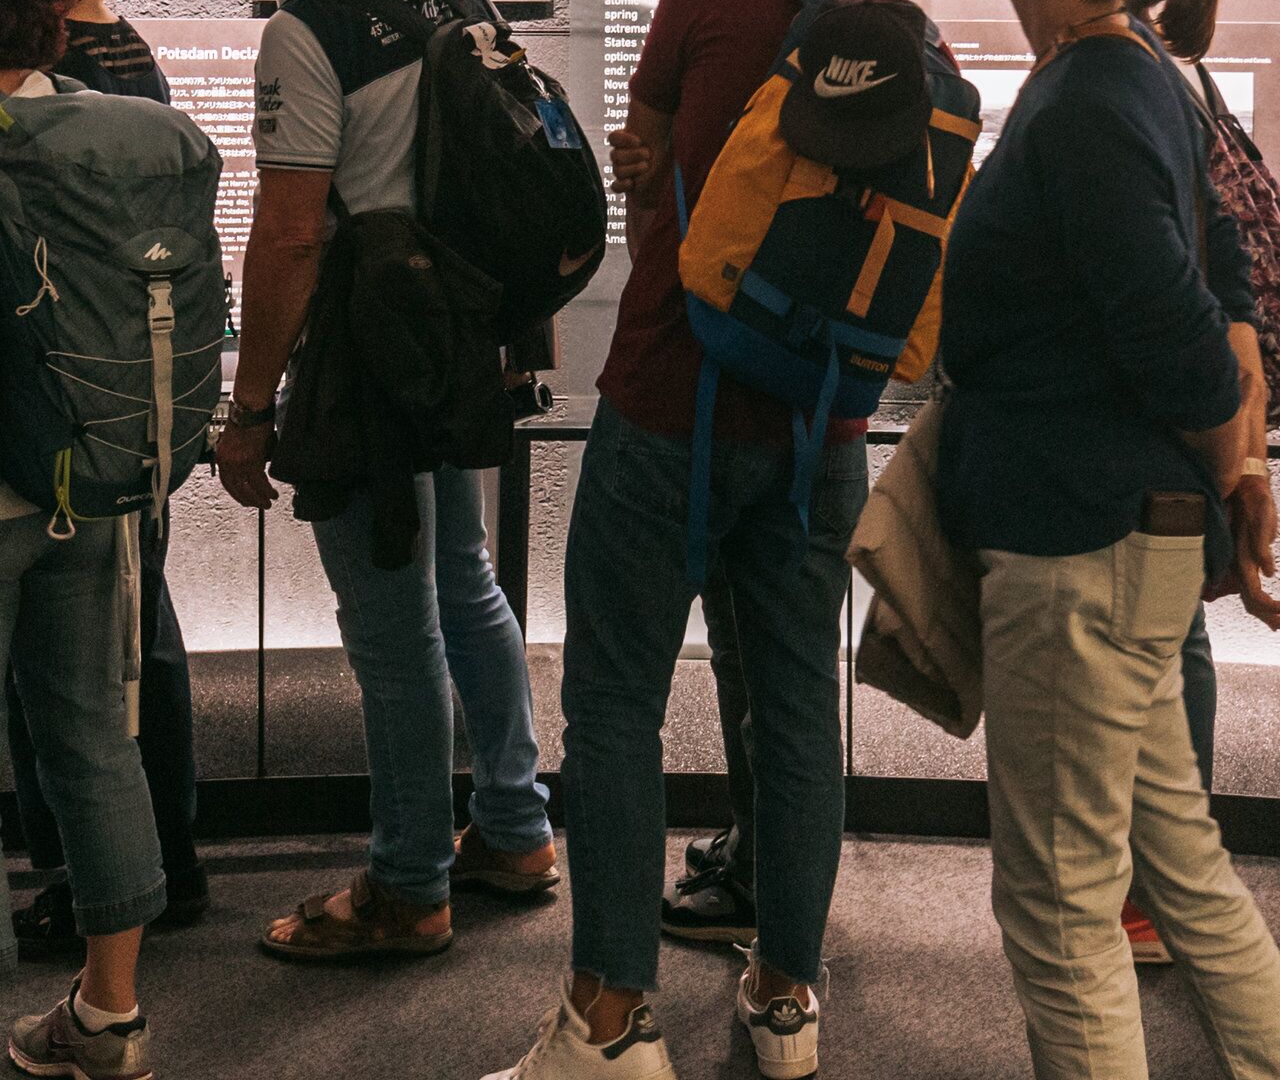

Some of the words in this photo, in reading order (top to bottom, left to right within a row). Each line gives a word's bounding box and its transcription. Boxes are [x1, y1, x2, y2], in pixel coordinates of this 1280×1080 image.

[157, 46, 218, 60] Potsdam
[221, 46, 259, 60] Decla
[825, 55, 877, 87] NIKE
[604, 107, 628, 119] Japa
